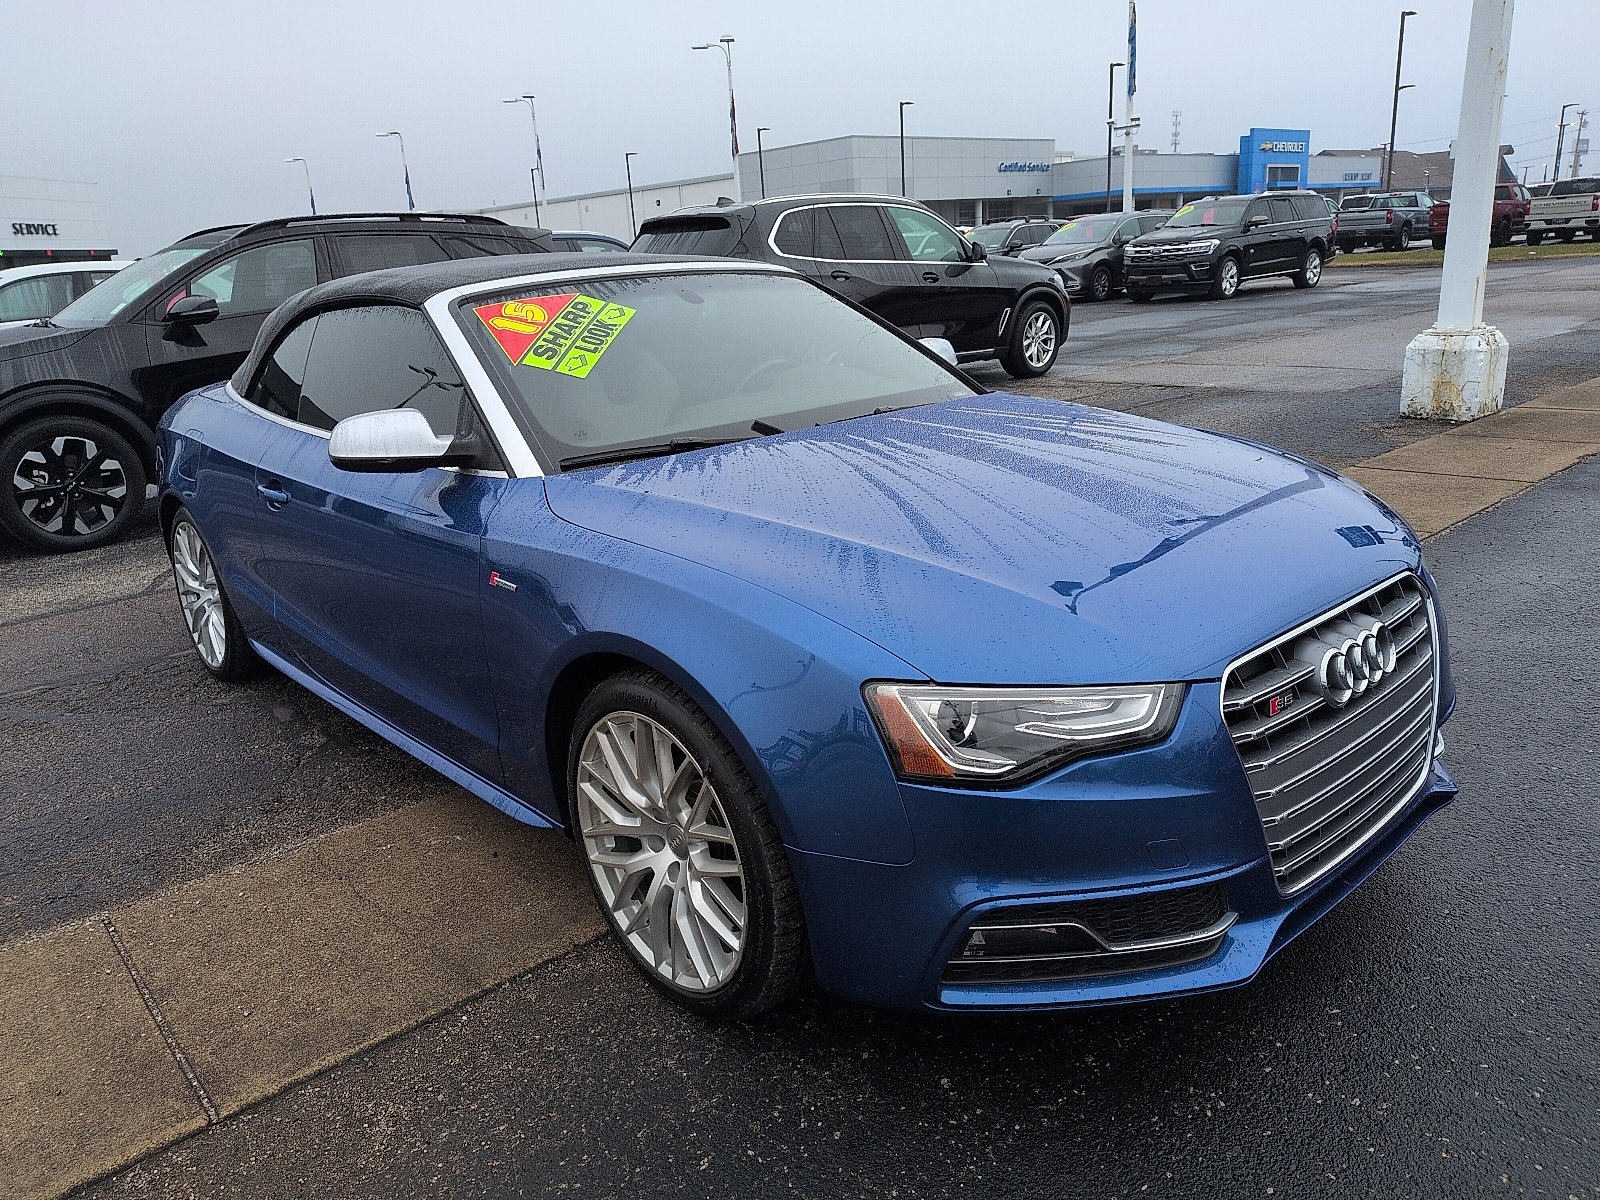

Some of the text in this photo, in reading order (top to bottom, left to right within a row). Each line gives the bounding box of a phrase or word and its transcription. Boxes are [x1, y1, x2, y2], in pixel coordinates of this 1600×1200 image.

[1273, 142, 1306, 152] CHEVROLET
[11, 223, 60, 236] SERVICE
[489, 301, 548, 334] 15
[532, 301, 594, 360] SHARP
[574, 319, 618, 354] LOOK
